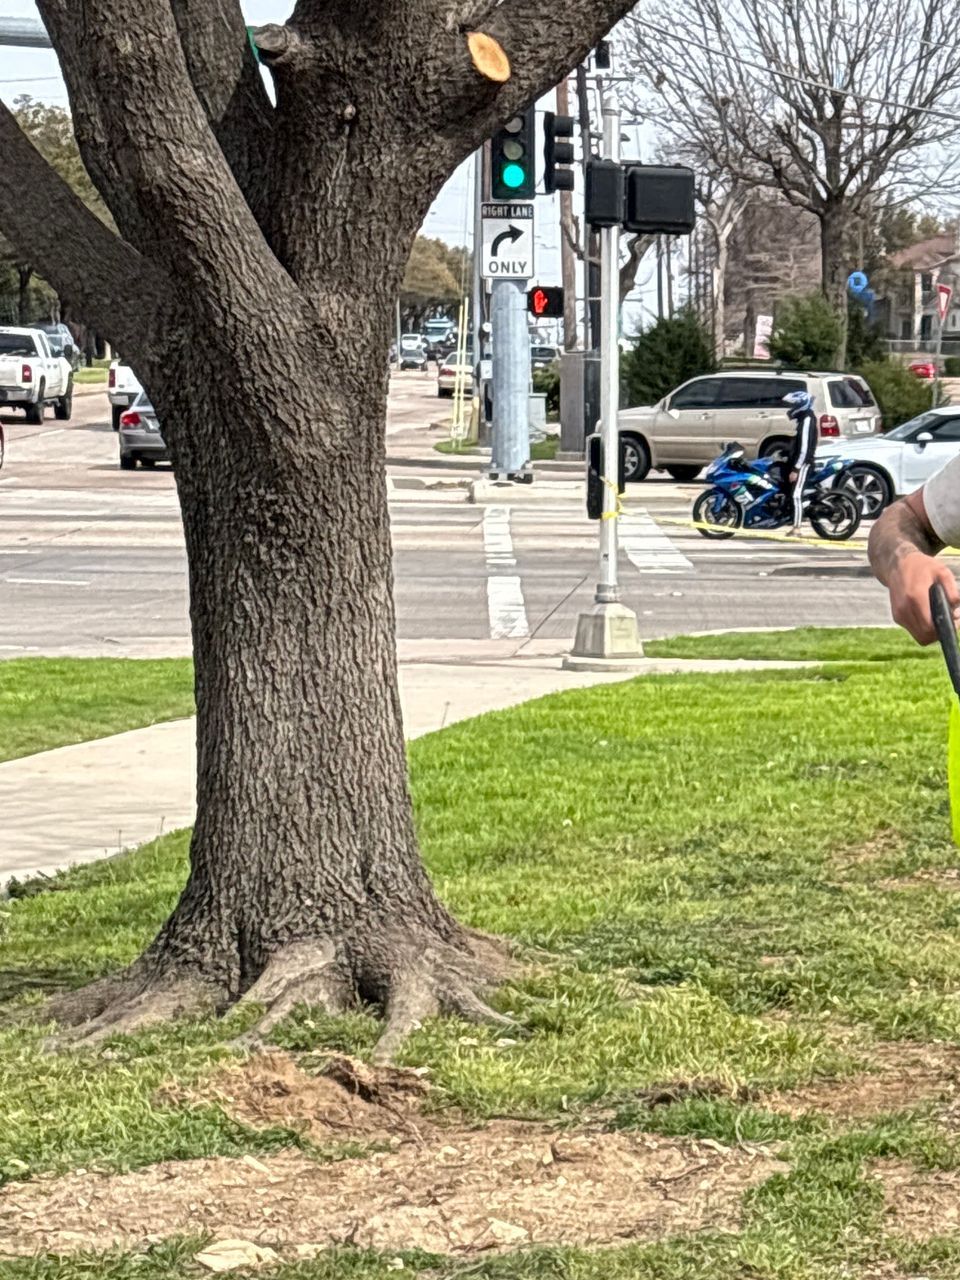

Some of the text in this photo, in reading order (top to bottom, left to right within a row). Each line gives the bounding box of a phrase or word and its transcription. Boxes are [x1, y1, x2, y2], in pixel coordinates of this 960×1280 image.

[482, 205, 533, 217] RIGHT LANE
[488, 260, 527, 274] ONLY
